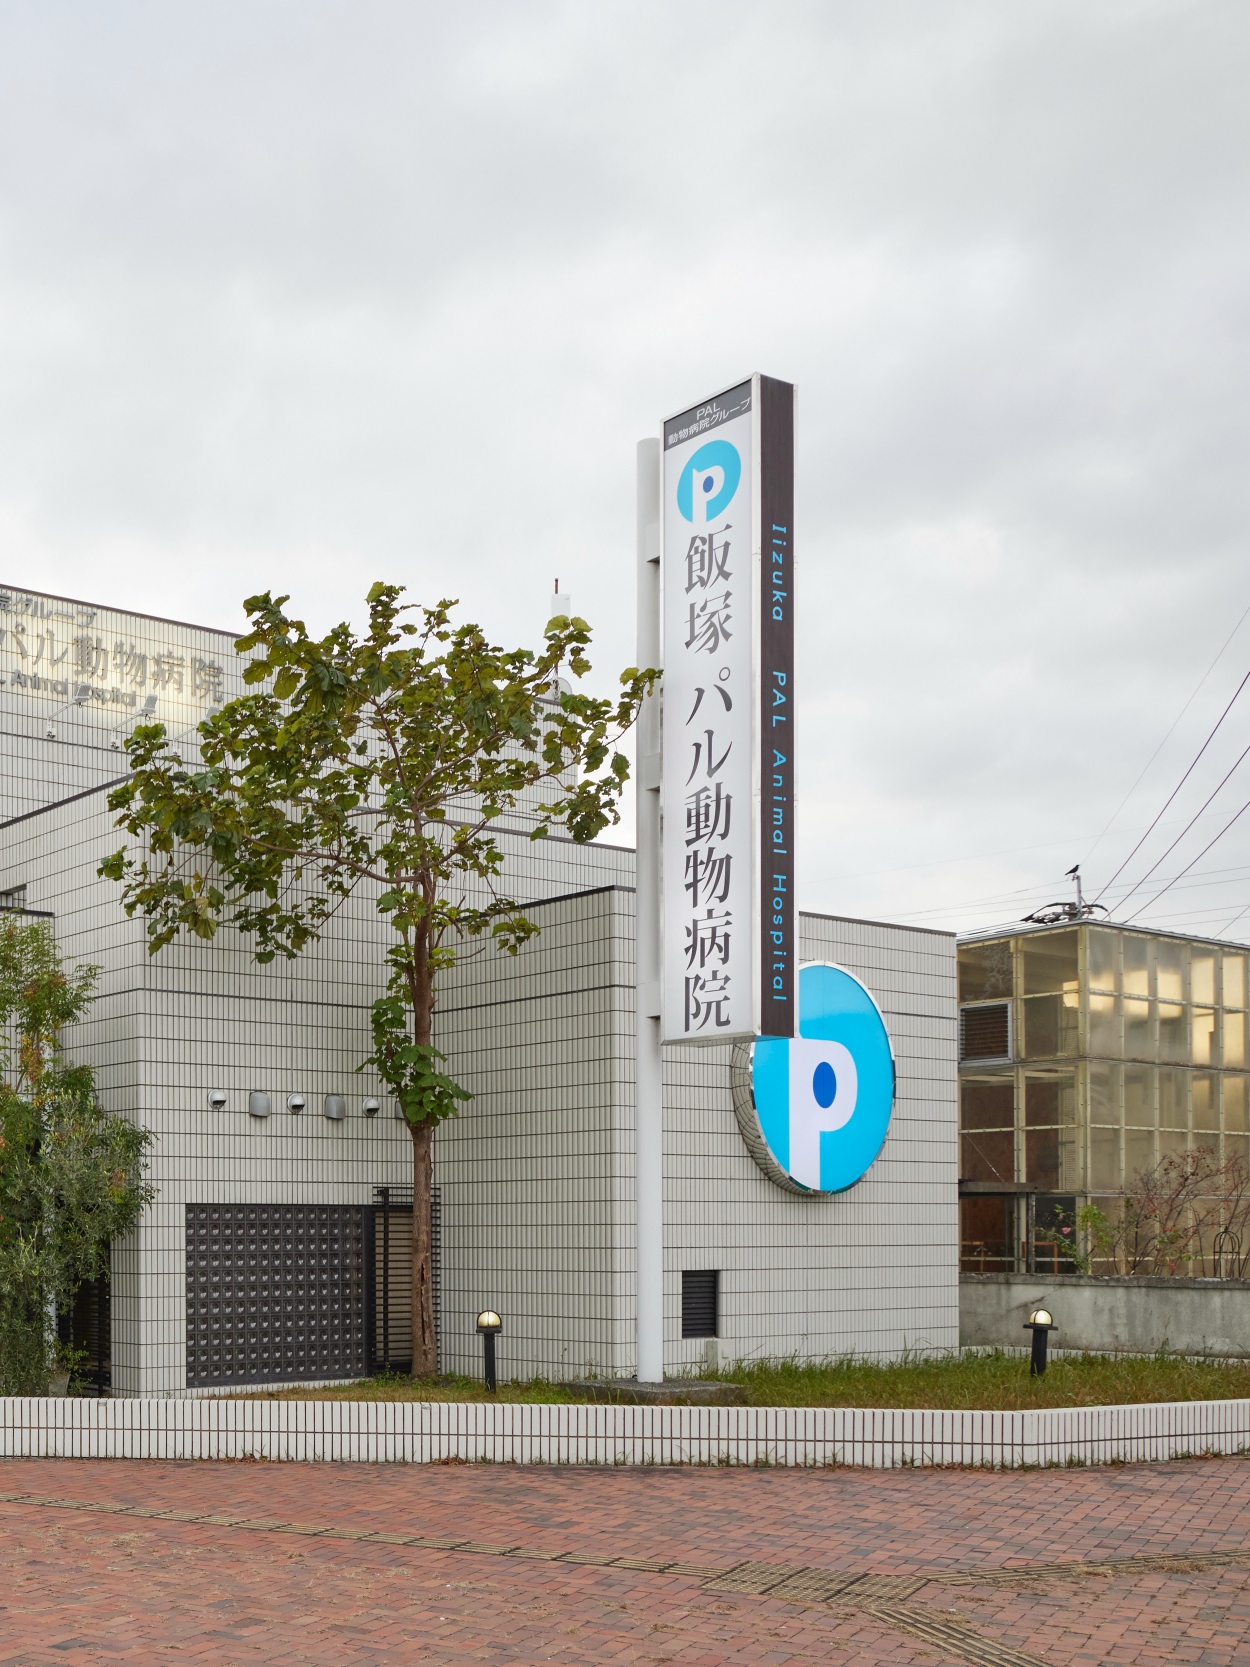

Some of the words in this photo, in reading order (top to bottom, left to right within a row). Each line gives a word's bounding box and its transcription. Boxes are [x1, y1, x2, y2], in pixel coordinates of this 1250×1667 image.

[668, 397, 752, 446] 動物病院グループ
[696, 402, 721, 420] PAL
[772, 523, 787, 622] Iizuka
[11, 668, 69, 696] Animal
[772, 671, 787, 728] PAL
[772, 749, 787, 854] Animal
[770, 874, 787, 1001] Hospital
